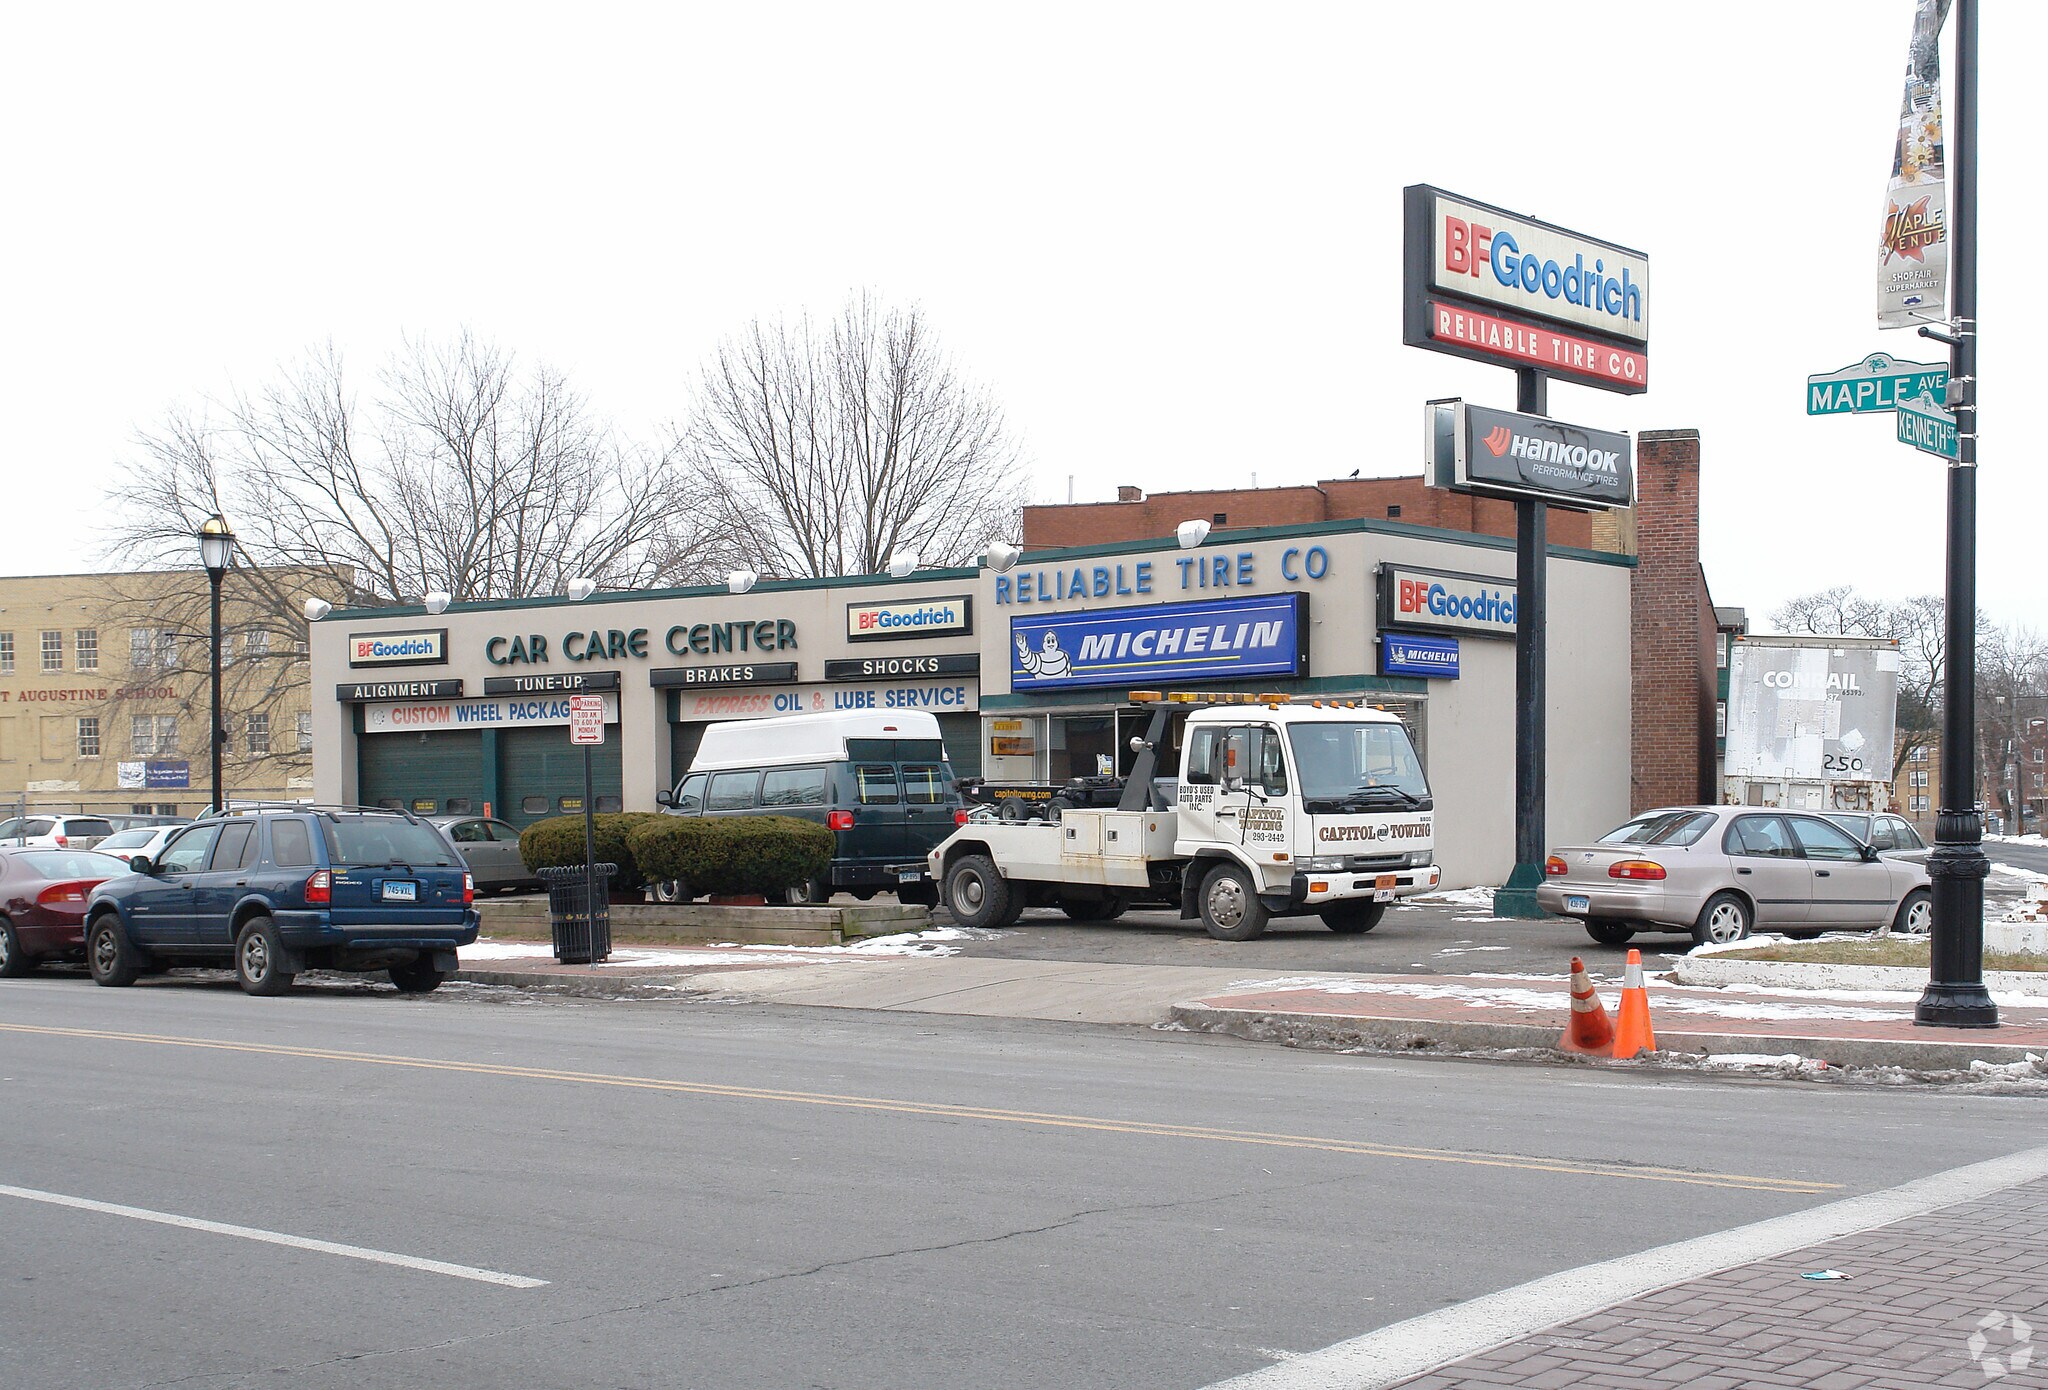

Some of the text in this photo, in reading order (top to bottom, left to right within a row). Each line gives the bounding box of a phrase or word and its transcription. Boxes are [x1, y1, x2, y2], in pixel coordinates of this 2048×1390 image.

[1885, 204, 1943, 240] MAPLE
[1445, 215, 1641, 322] BFGoodrich
[1892, 269, 1932, 282] SHOP FAIR
[1885, 280, 1939, 293] SUPERMARKET
[1439, 310, 1642, 380] RELIABLE TIRE CO.
[1811, 374, 1945, 411] MAPLE AVE
[1899, 411, 1956, 450] KENNETH ST
[1532, 463, 1619, 487] PERFORMANCE TIRES
[995, 544, 1329, 605] RELIABLE TIRE CO
[858, 606, 955, 630] BFGoodrich
[357, 639, 433, 657] BFGoodrich
[485, 618, 798, 665] CAR CARE CENTER
[1078, 620, 1284, 661] MICHELIN
[1407, 649, 1458, 663] MICHELIN
[686, 667, 754, 683] BRAKES
[863, 658, 939, 675] SHOCKS
[354, 683, 439, 698] ALIGNMENT
[514, 675, 583, 692] TUNE-UP
[18, 689, 108, 702] AUGUSTINE
[116, 687, 178, 700] SCHOOL
[693, 687, 965, 715] EXPRESS OIL & LUBE SERVICE
[572, 699, 581, 709] NO
[392, 706, 450, 725] CUSTOM
[455, 702, 503, 723] WHEEL
[578, 726, 597, 734] MONDAY
[1823, 754, 1863, 772] 250
[994, 789, 1052, 800] capitoltowing.com
[1179, 785, 1215, 795] BOYD'S USED
[1179, 794, 1212, 803] AUTO PARTS
[1189, 803, 1204, 811] INC.
[1238, 808, 1284, 820] CAPITOL
[1239, 820, 1283, 831] TOWING
[1319, 825, 1376, 842] CAPITOL
[1390, 823, 1431, 839] TOWING
[1252, 832, 1285, 842] 293-2442
